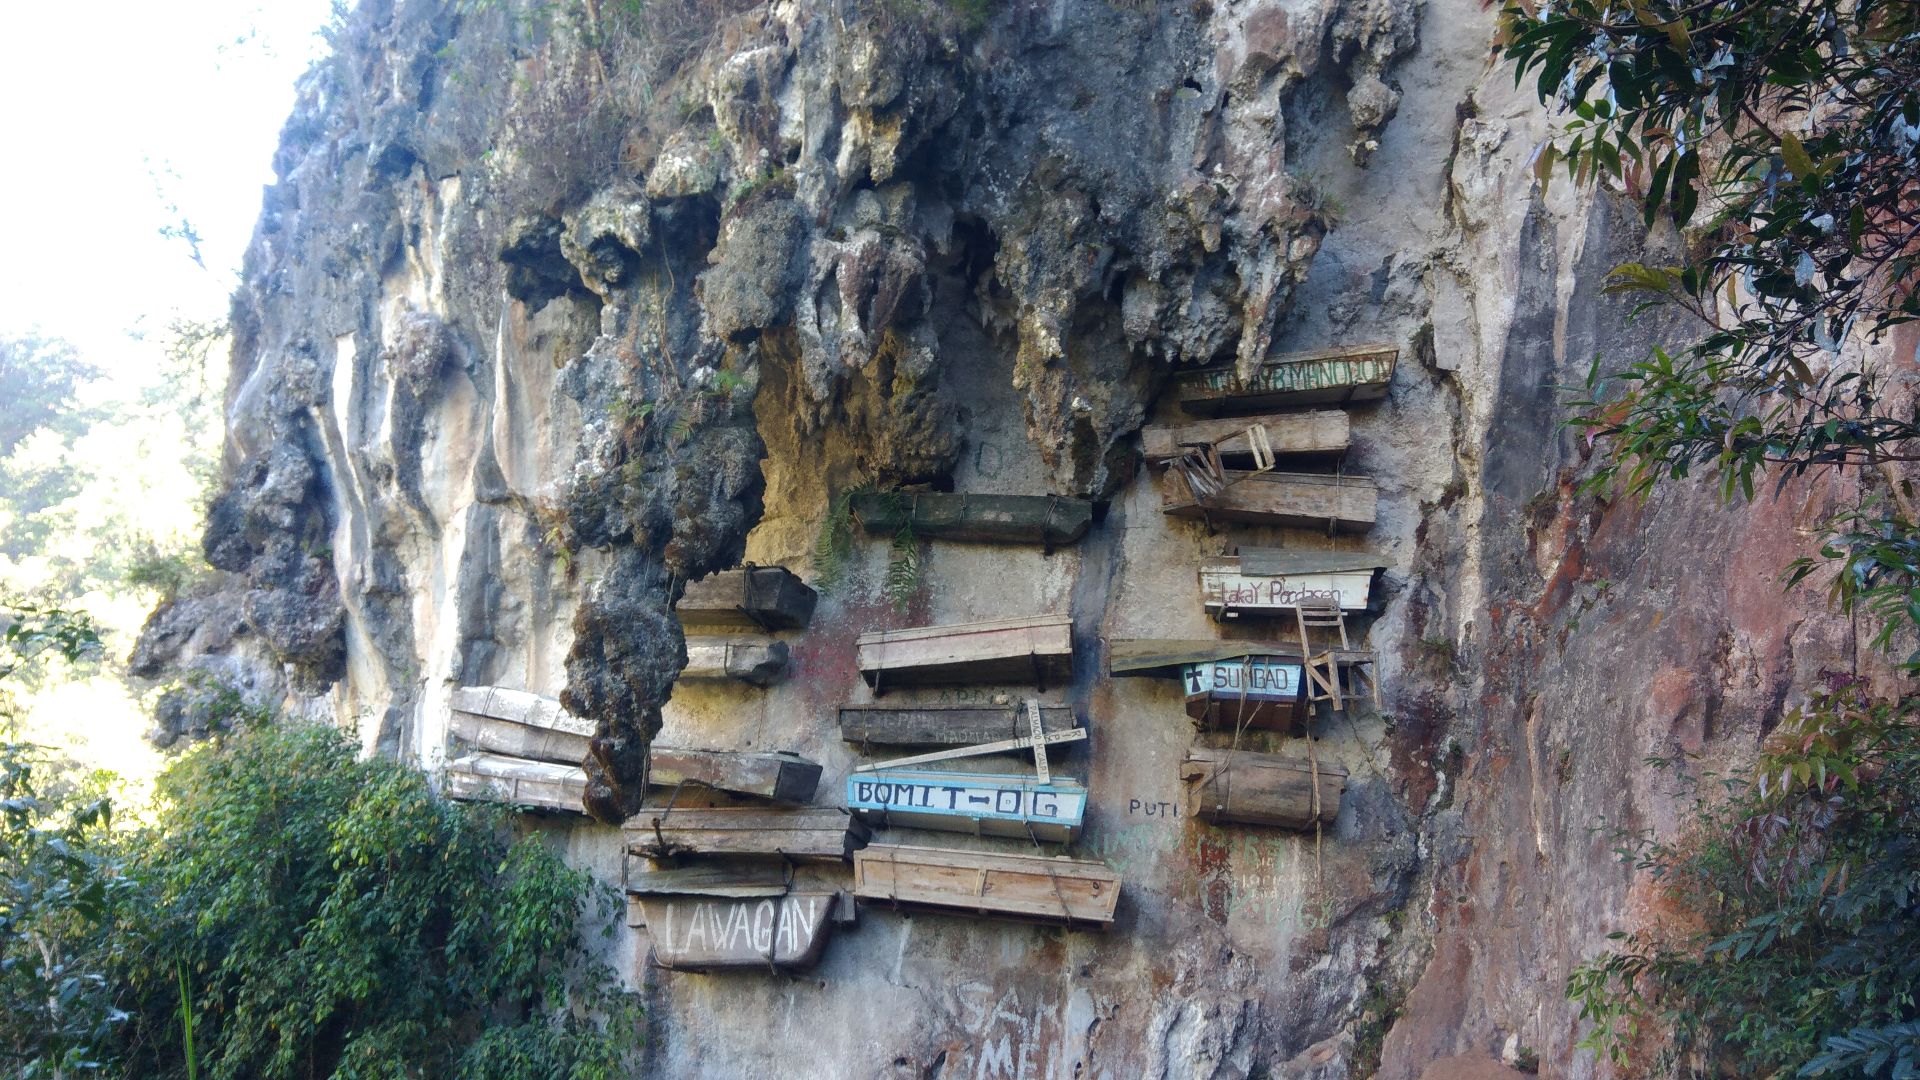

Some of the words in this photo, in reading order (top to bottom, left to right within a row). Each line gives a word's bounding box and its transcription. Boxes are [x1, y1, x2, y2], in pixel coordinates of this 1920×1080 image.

[858, 781, 1058, 818] BOMIT-OG
[1129, 799, 1178, 818] PUTI
[665, 899, 815, 954] LAWAGAN
